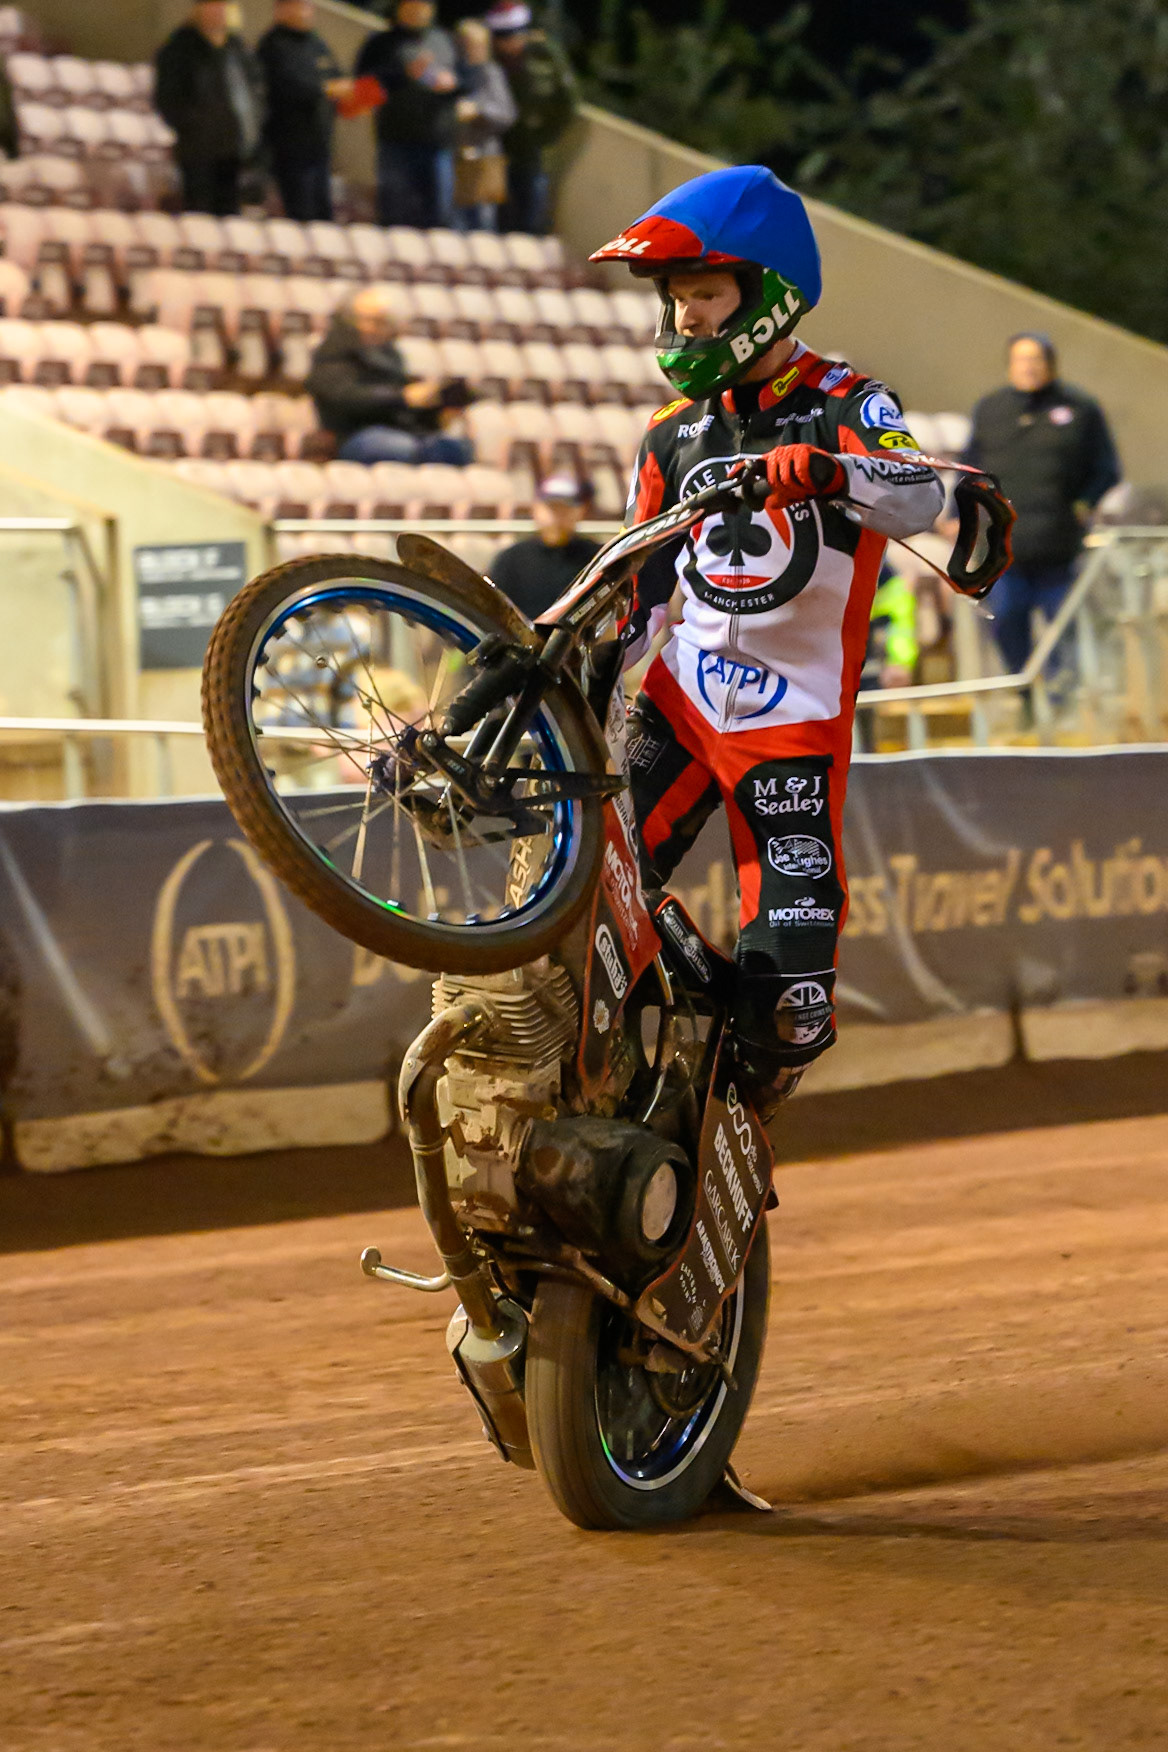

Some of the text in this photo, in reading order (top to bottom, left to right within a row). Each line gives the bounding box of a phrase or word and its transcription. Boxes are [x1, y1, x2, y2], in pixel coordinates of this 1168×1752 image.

[704, 655, 770, 694] ATPI
[753, 775, 822, 798] M & J
[754, 793, 824, 817] Sealey
[768, 907, 835, 922] MOTOREX
[713, 1121, 754, 1234] BECKHOFF
